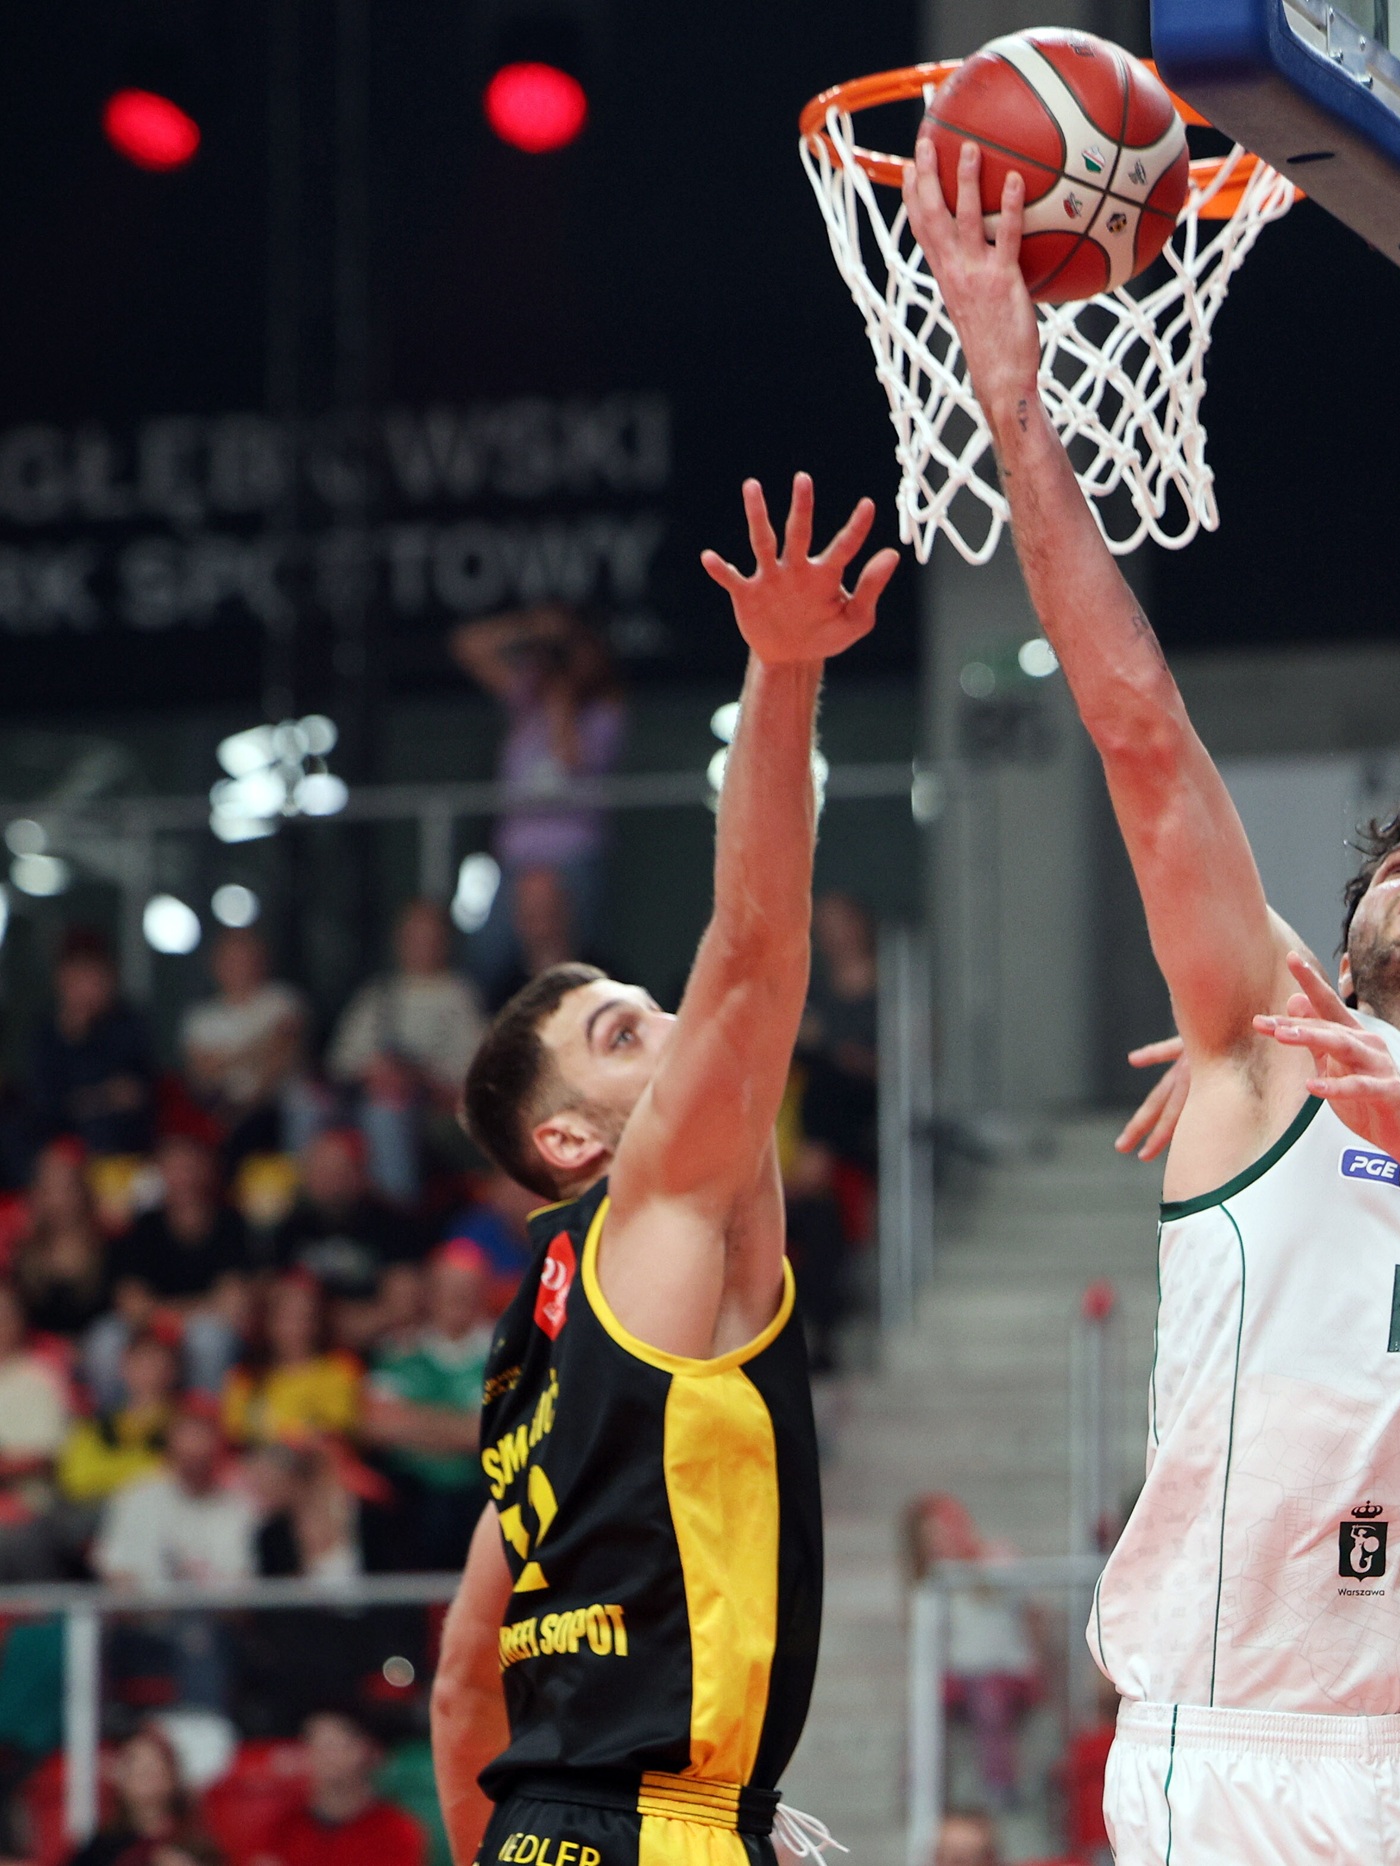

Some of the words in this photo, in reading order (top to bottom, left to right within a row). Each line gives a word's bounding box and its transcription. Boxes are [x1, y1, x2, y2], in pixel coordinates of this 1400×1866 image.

[1349, 1155, 1399, 1179] PGE
[1337, 1588, 1385, 1597] Warszawa
[539, 1603, 629, 1657] SOPOT
